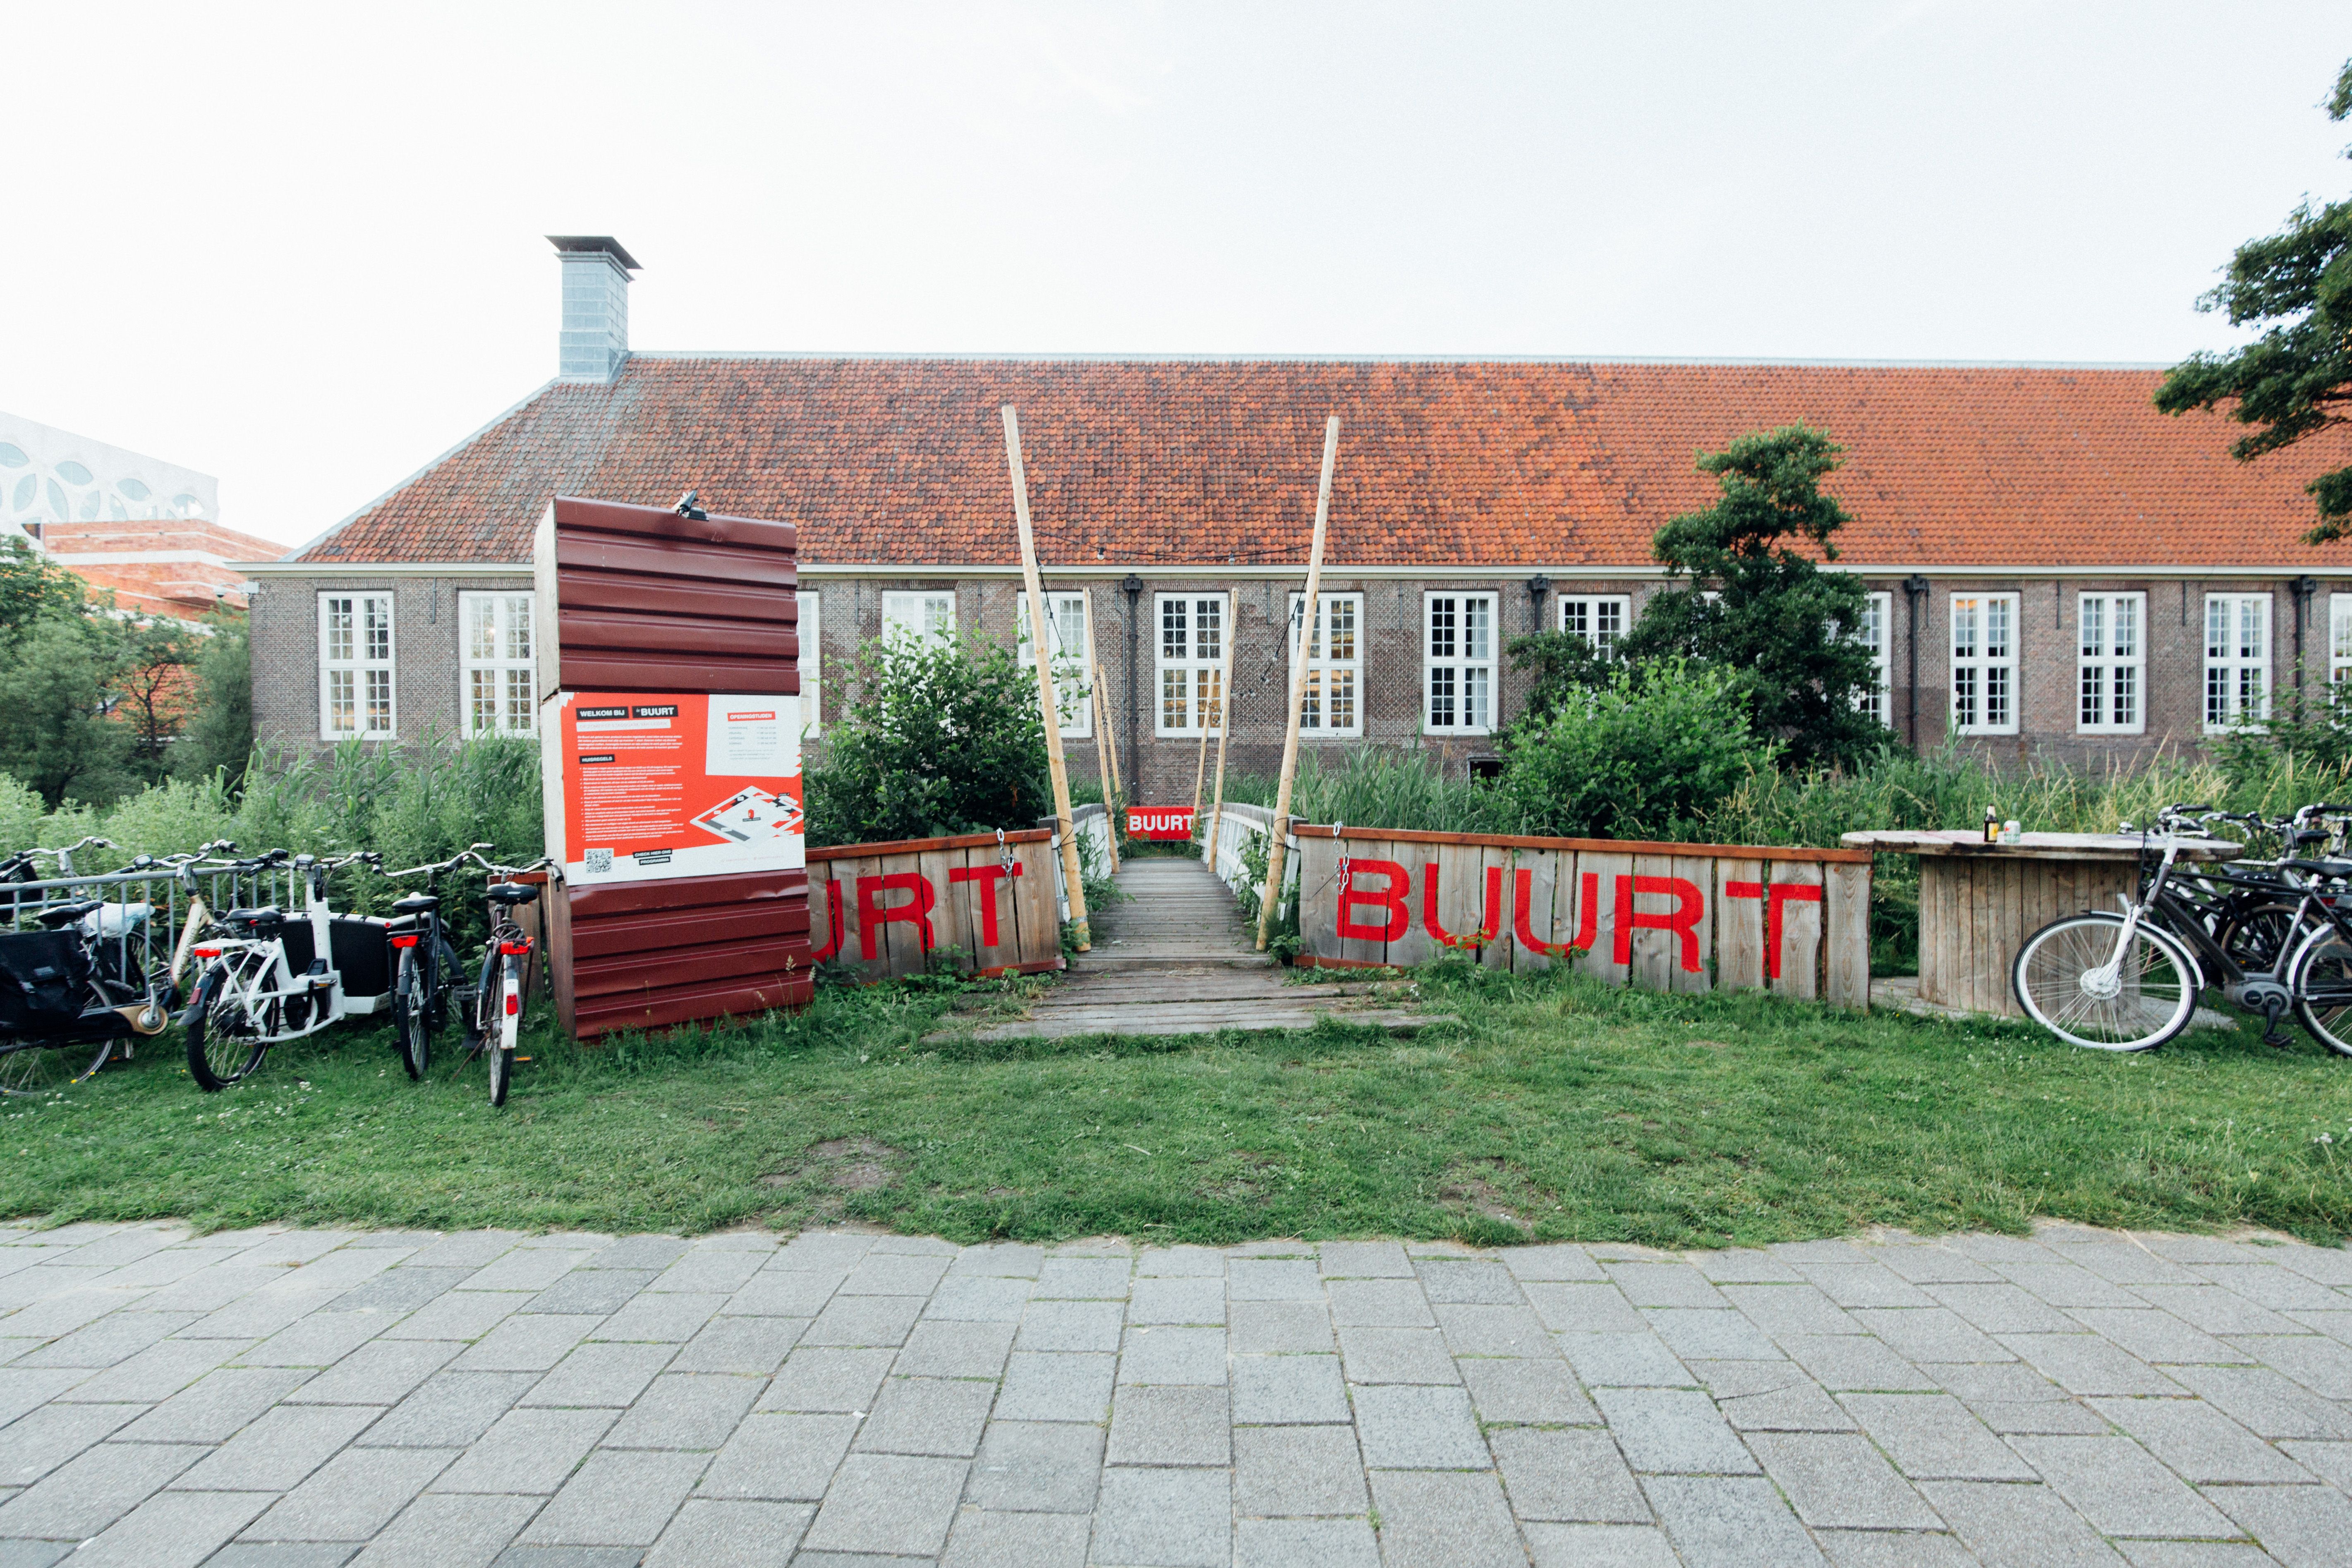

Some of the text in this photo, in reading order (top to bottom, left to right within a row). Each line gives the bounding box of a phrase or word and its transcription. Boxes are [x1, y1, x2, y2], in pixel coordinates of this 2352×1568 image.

[641, 707, 674, 716] BUURT
[1129, 815, 1194, 831] BUURT
[1336, 858, 1821, 979] BUURT
